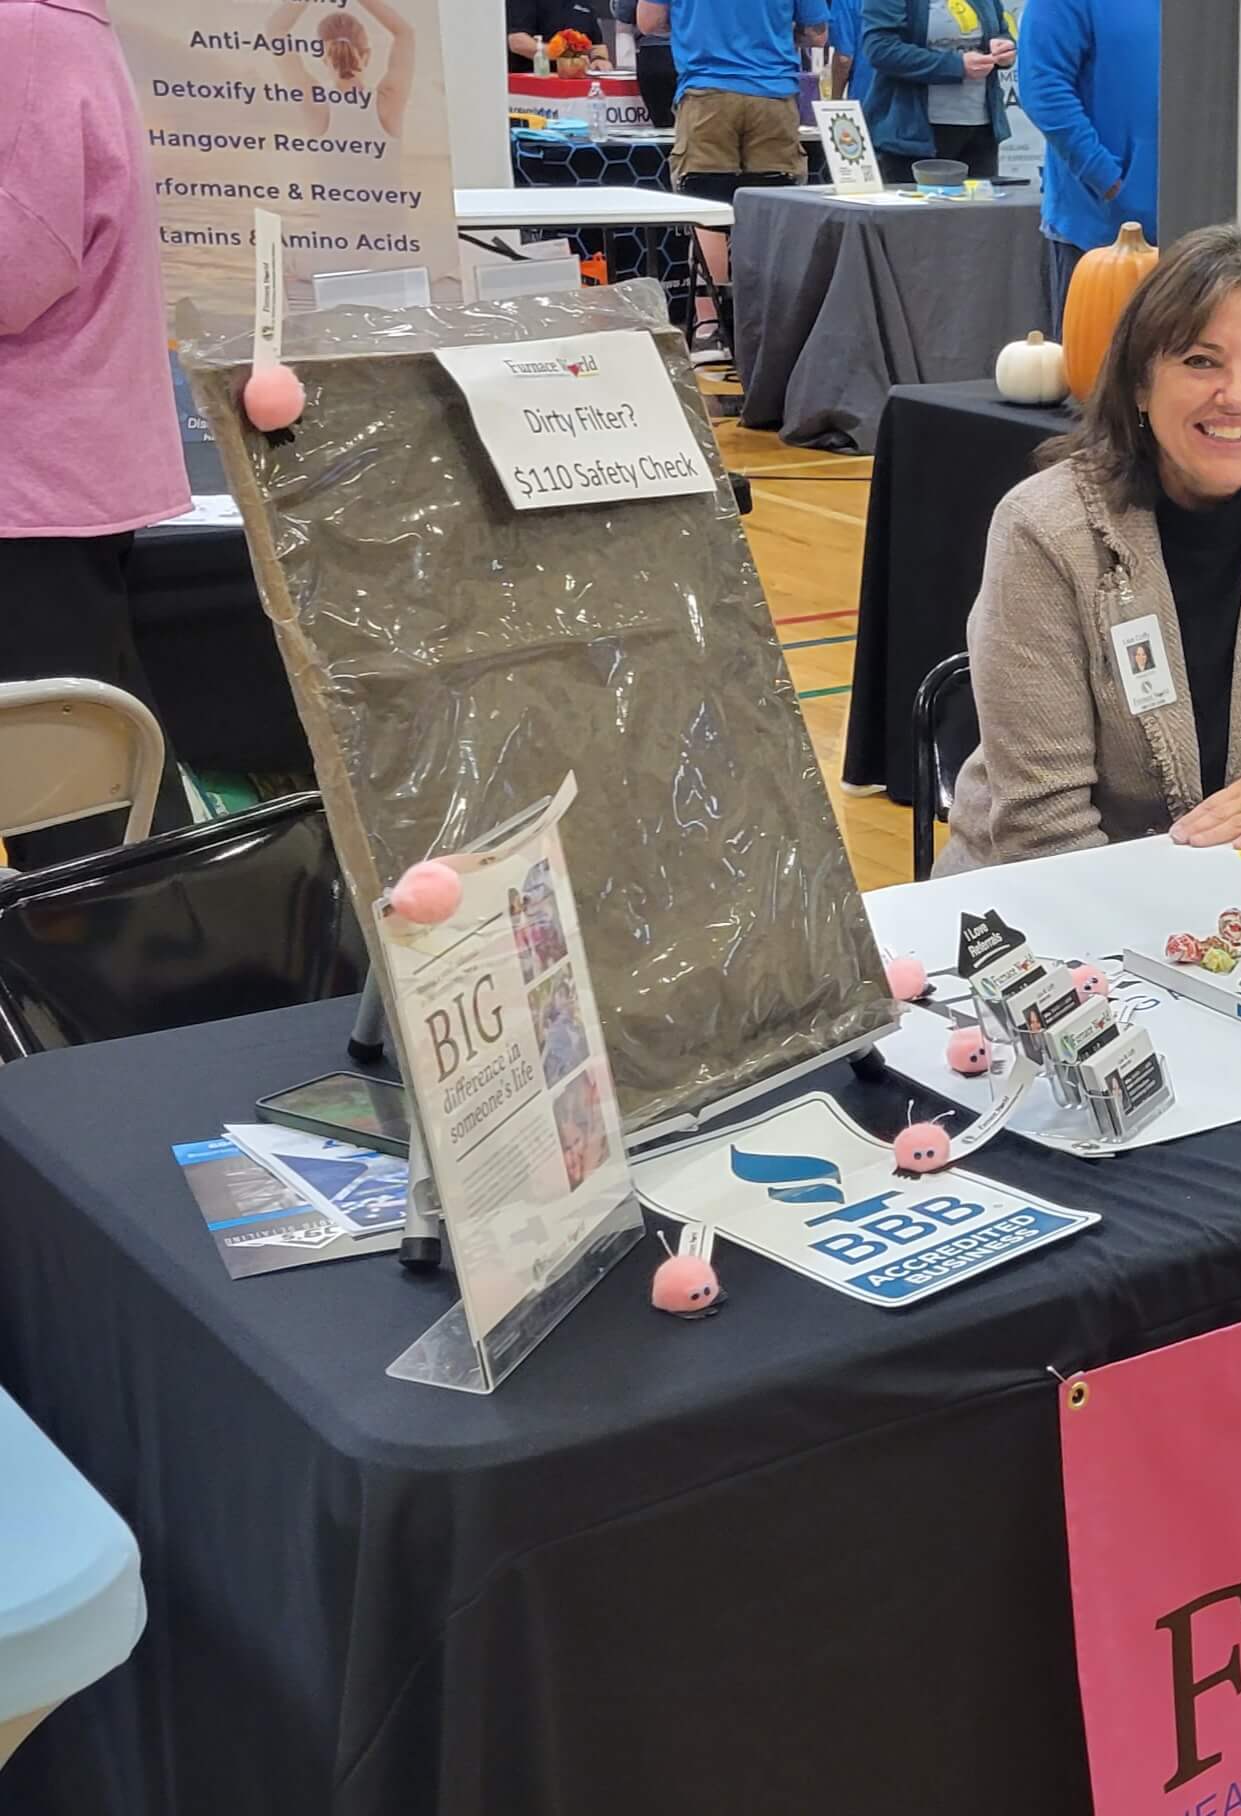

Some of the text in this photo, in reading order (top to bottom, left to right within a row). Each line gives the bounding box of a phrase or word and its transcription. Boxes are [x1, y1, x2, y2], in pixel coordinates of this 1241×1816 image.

[190, 31, 325, 57] Anti-Aging
[153, 79, 372, 109] Detoxify the Body
[606, 106, 654, 123] OLOR
[149, 129, 387, 159] Hangover Recovery
[155, 178, 422, 208] rformance & Recovery
[159, 226, 242, 246] tamins
[280, 230, 349, 251] mino
[356, 233, 421, 252] Acids
[503, 359, 559, 375] Furnace
[523, 403, 638, 438] Dirty Filter?
[513, 452, 699, 499] $110 Safety Check
[967, 931, 1003, 959] Referrals
[971, 922, 989, 940] Love
[423, 973, 504, 1084] BIG
[442, 1042, 521, 1115] difference in
[450, 1061, 535, 1145] someone's life
[808, 1195, 986, 1265] BBB
[868, 1212, 1036, 1288] ACCREDITED
[912, 1227, 1042, 1286] BUSINESS
